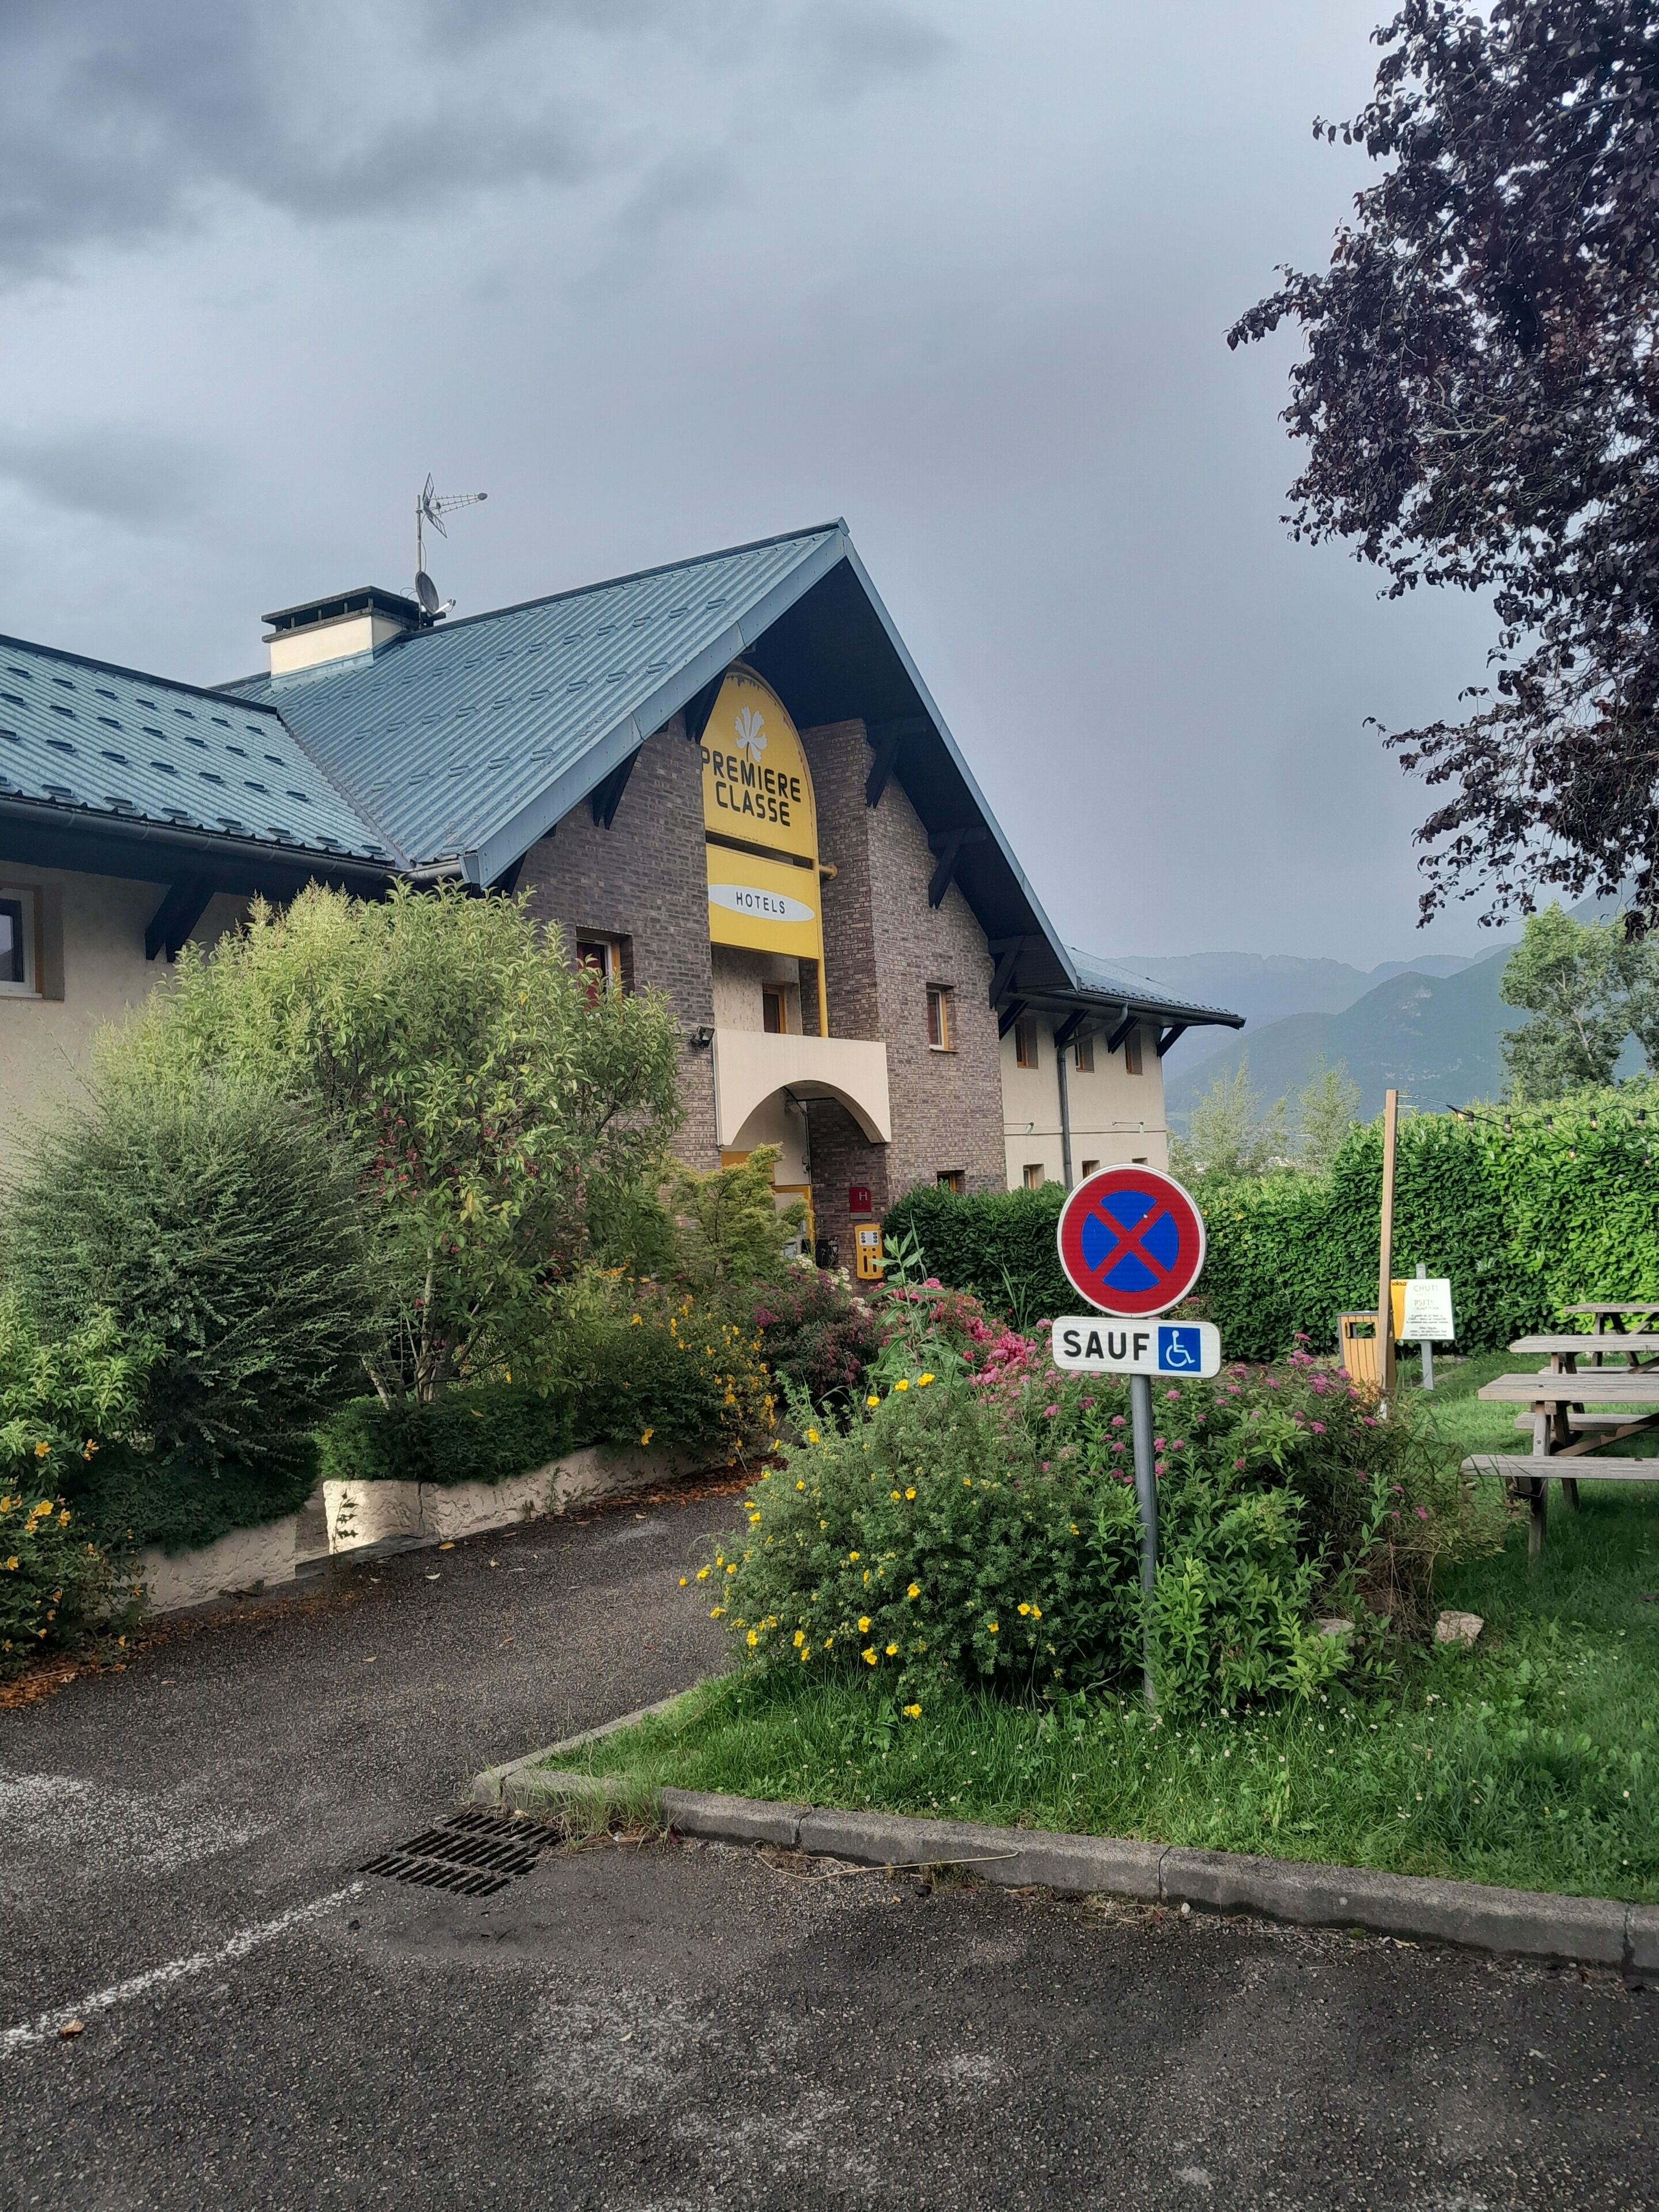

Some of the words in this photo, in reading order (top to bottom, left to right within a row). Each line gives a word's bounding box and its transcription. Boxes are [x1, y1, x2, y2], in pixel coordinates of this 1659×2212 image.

[701, 747, 801, 803] PREMIERE
[715, 781, 791, 827] CLASSE
[736, 892, 785, 914] HOTELS
[858, 1191, 868, 1201] H
[1063, 1330, 1150, 1361] SAUF
